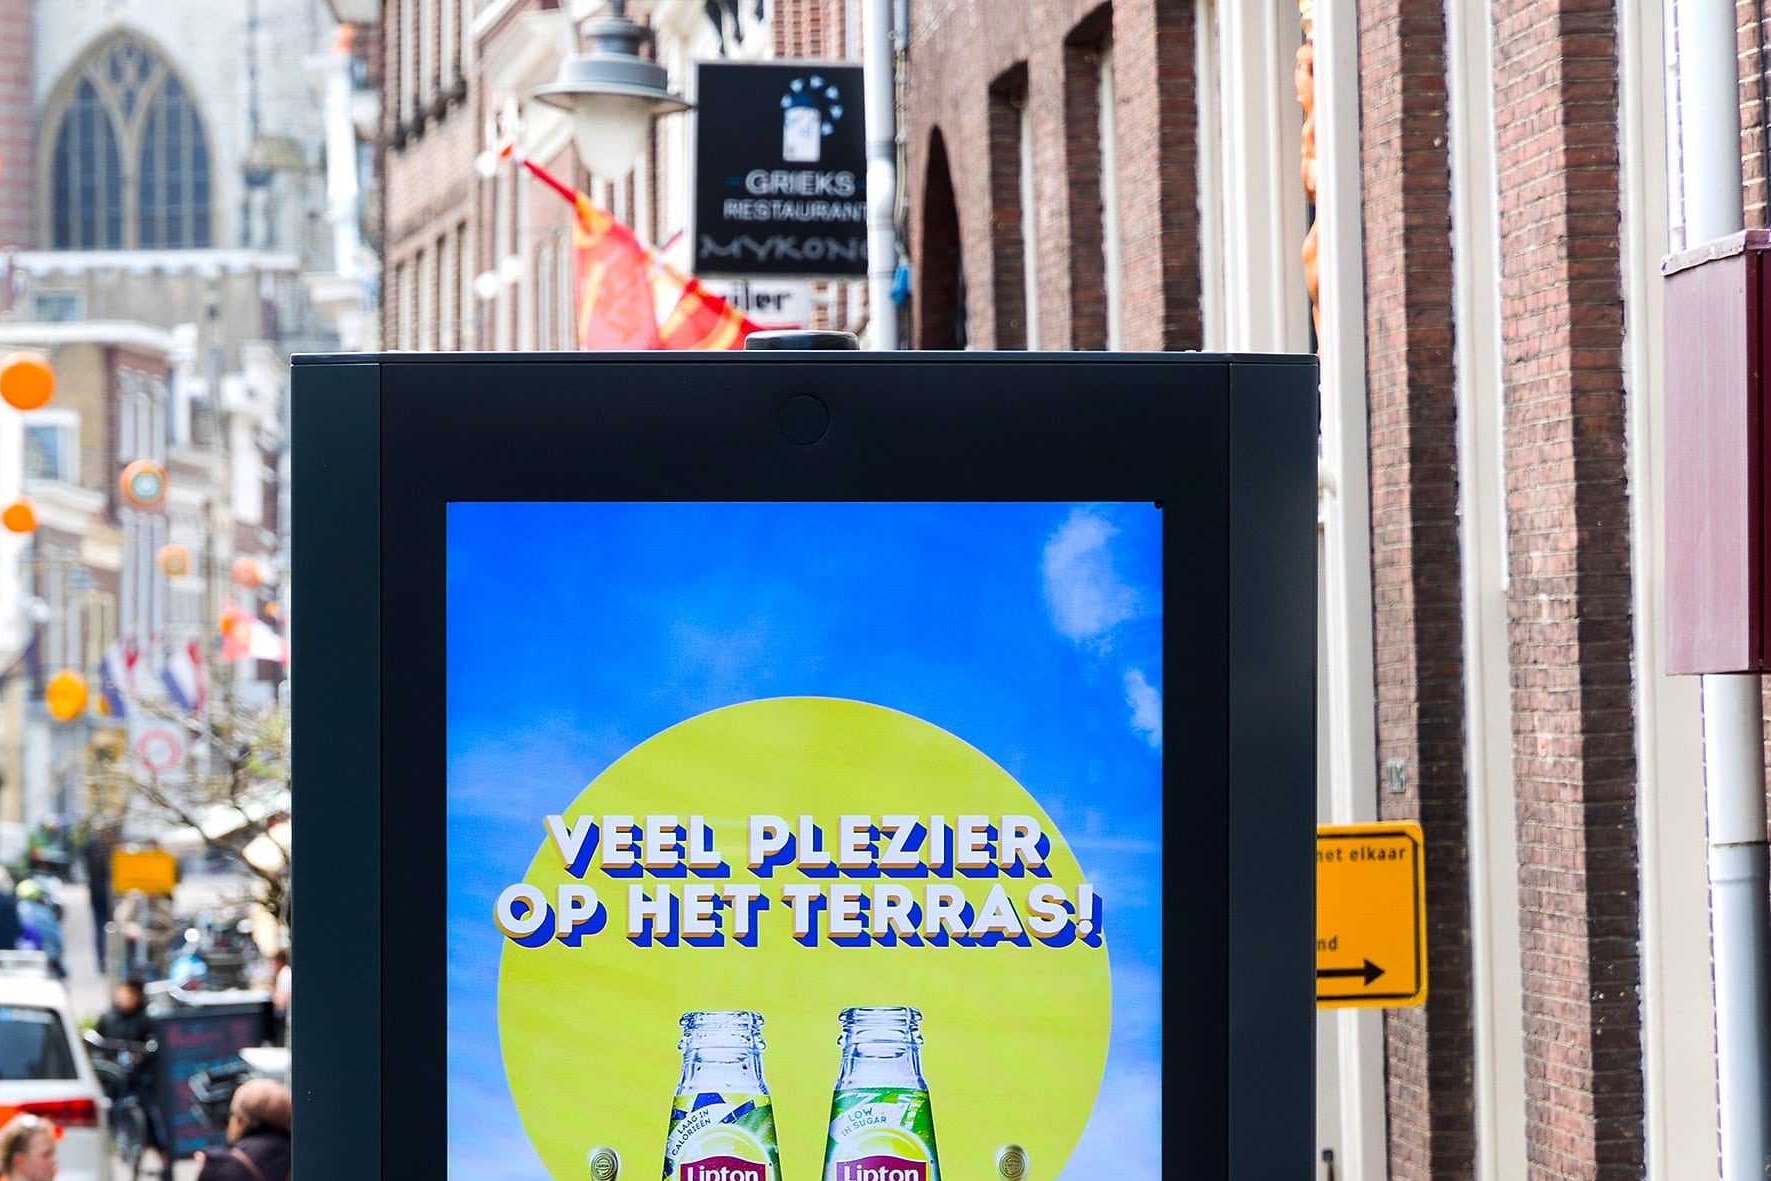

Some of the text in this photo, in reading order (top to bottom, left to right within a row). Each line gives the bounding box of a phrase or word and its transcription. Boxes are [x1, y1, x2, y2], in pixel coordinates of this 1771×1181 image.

[745, 169, 857, 197] GRIEKS
[545, 815, 1053, 878] VEEL PLEZIER
[1350, 845, 1406, 861] elkaar
[496, 883, 1103, 949] OP HET TERRAS!
[1317, 935, 1338, 951] nd
[677, 1108, 710, 1135] LAAG IN
[848, 1107, 873, 1121] LOW
[841, 1116, 887, 1136] IN SUGAR
